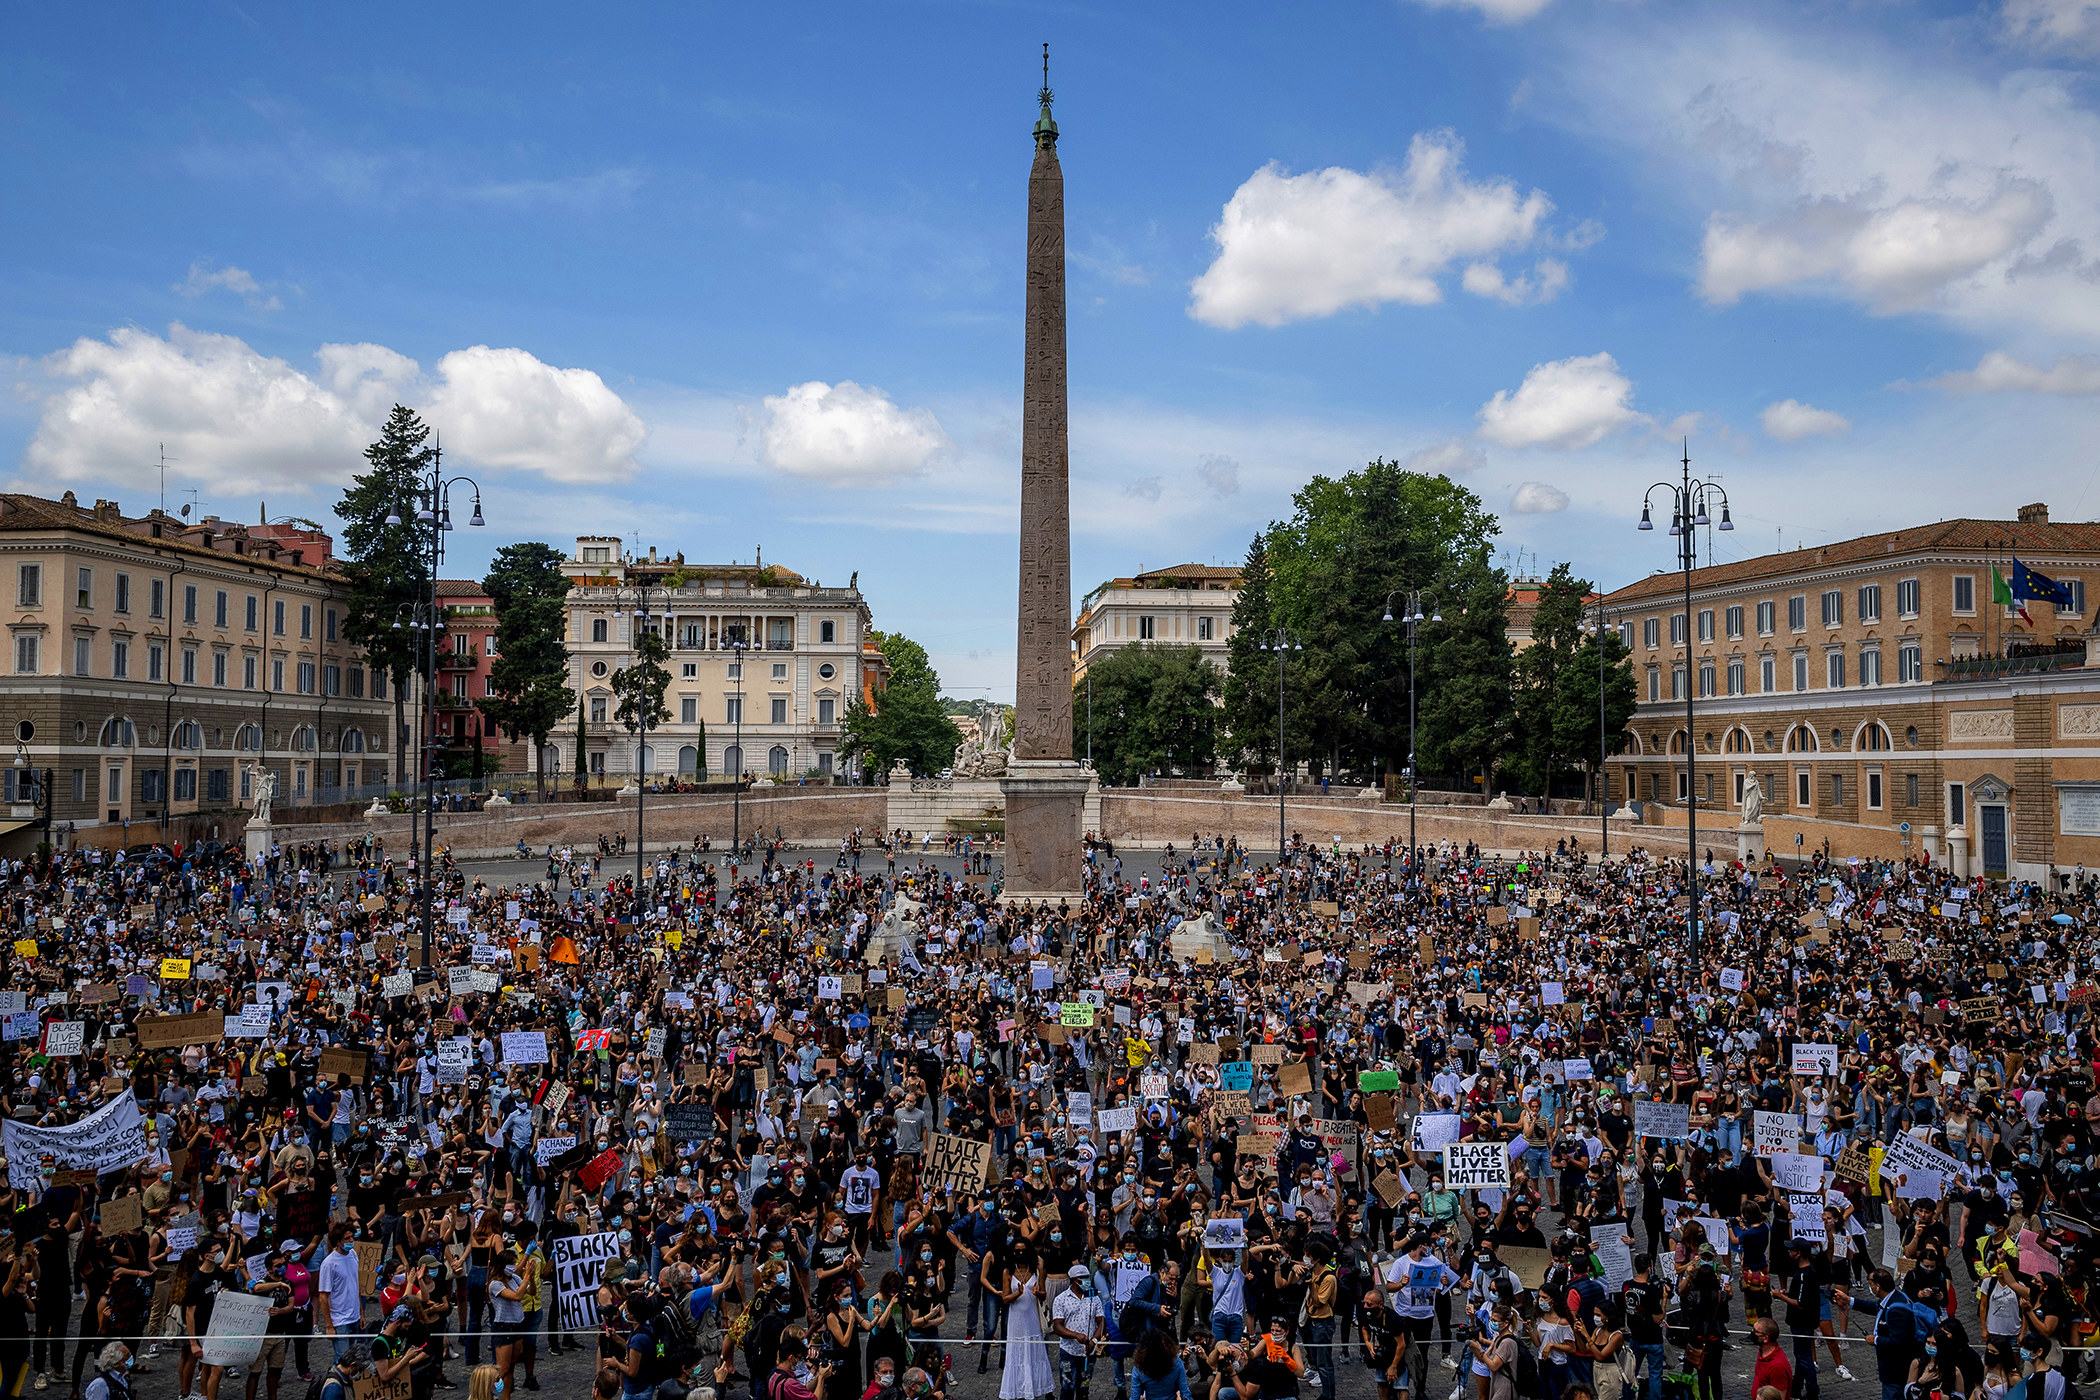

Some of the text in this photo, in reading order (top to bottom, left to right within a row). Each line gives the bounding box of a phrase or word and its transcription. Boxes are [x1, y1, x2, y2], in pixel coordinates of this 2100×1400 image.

[52, 1023, 82, 1032] BLACK
[49, 1032, 82, 1043] LIVES
[504, 1050, 525, 1060] LAST
[646, 1049, 661, 1057] PEACE
[1222, 1063, 1249, 1074] WE WILL
[469, 1080, 480, 1090] 35
[1142, 1076, 1146, 1084] I
[1102, 1109, 1134, 1120] NO JUSTICE
[1103, 1118, 1134, 1129] NO PEACE
[1415, 1116, 1458, 1129] BLACK
[1766, 1115, 1784, 1126] NO
[13, 1118, 119, 1150] VOLARE COME GLI
[1414, 1127, 1450, 1137] LIVES
[1758, 1125, 1795, 1138] JUSTICE
[544, 1138, 575, 1148] CHANGE
[1327, 1136, 1343, 1145] NECK
[1765, 1137, 1782, 1145] NO
[936, 1135, 984, 1160] BLACK
[1450, 1146, 1502, 1157] BLACK
[1895, 1131, 1908, 1145] I
[1905, 1141, 1958, 1173] UNDERSTAND
[80, 1150, 101, 1162] NON
[105, 1148, 114, 1156] A
[596, 1152, 611, 1165] SAY
[1843, 1149, 1872, 1165] BLACK
[1893, 1143, 1901, 1152] I
[1902, 1149, 1924, 1166] WILL
[598, 1155, 618, 1172] DOWN
[612, 1161, 620, 1170] UP
[931, 1152, 981, 1176] LIVES
[1450, 1158, 1502, 1168] LIVES
[1785, 1164, 1807, 1172] WANT
[1841, 1157, 1870, 1172] LIVES
[1448, 1169, 1507, 1184] MATTER
[1836, 1165, 1867, 1183] MATTER
[1911, 1169, 1928, 1177] NO
[923, 1166, 981, 1194] MATTER
[1775, 1171, 1811, 1188] JUSTICE
[298, 1193, 311, 1202] NO
[1791, 1195, 1824, 1205] BLACK
[359, 1246, 382, 1259] NOT
[555, 1233, 617, 1264] BLACK
[362, 1258, 381, 1272] BUT
[1119, 1261, 1123, 1269] I
[557, 1259, 605, 1292] LIVE
[364, 1382, 409, 1400] MATTER
